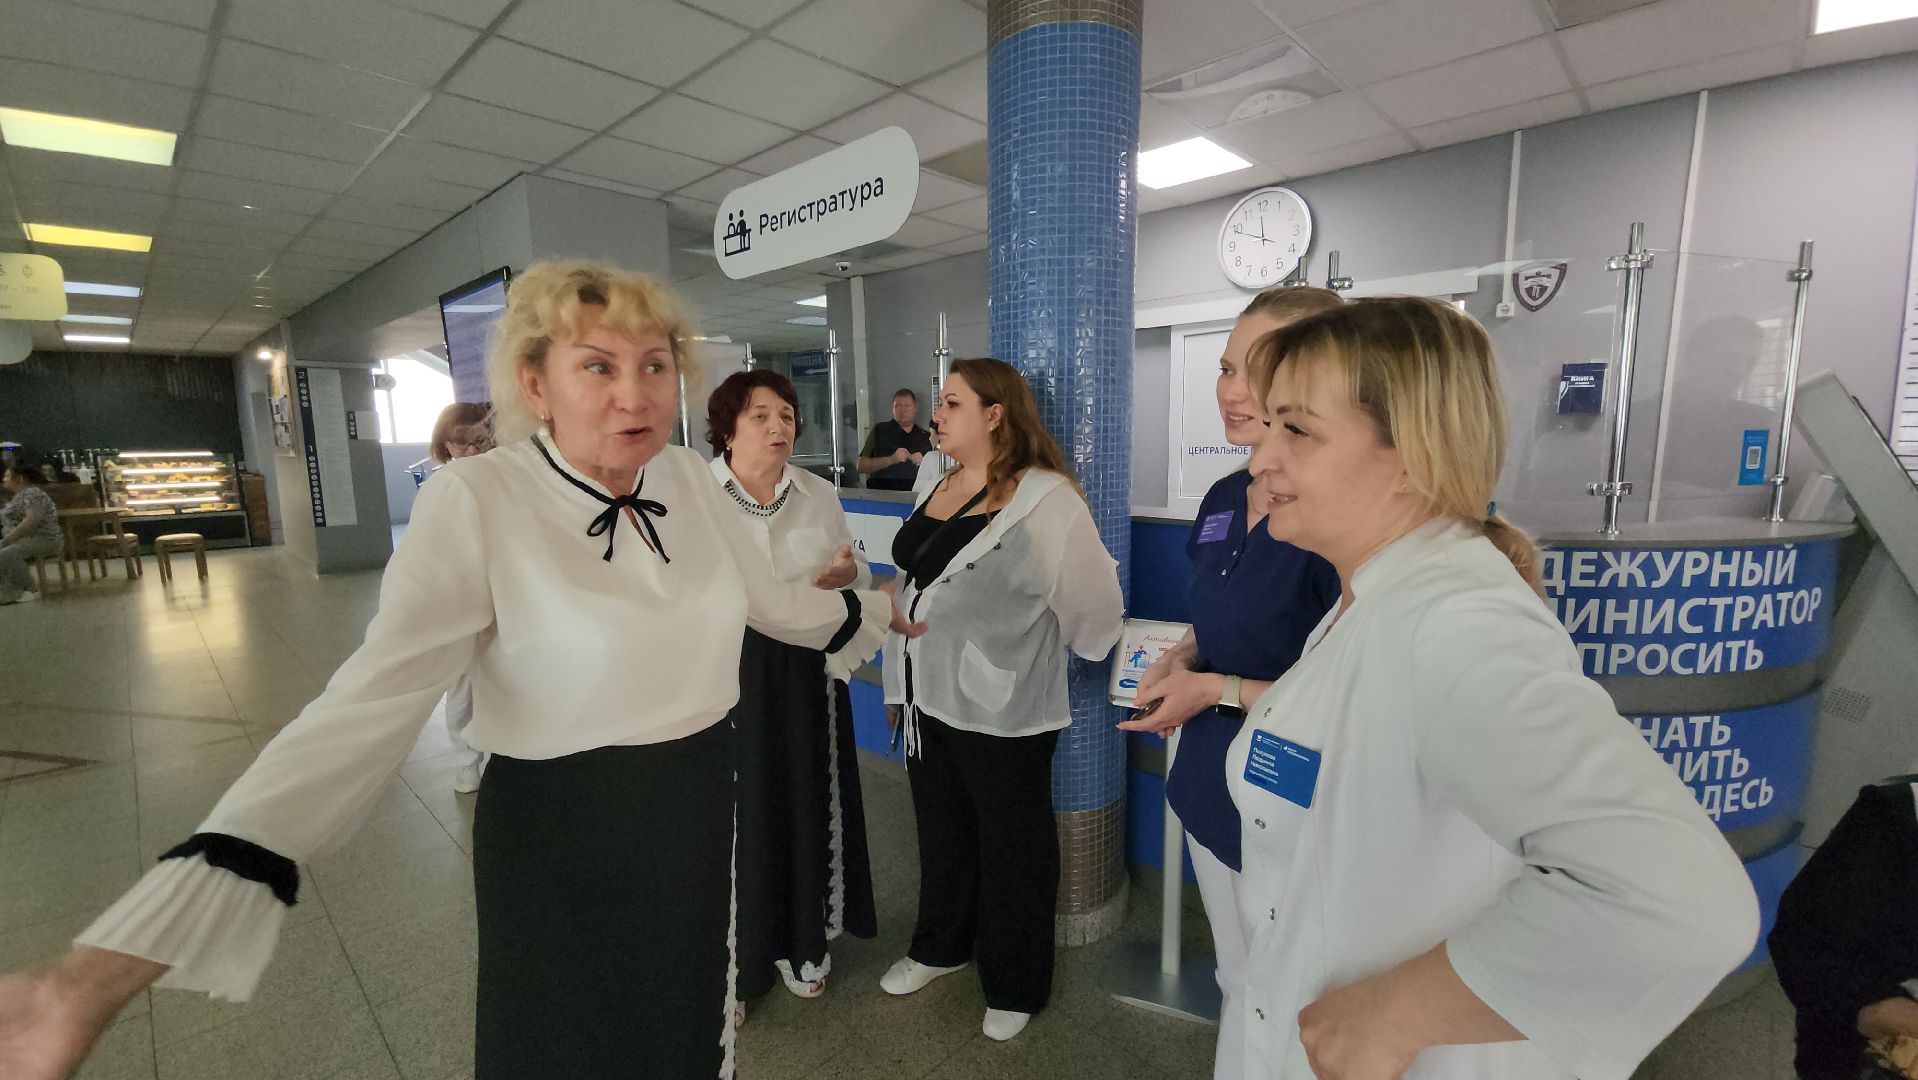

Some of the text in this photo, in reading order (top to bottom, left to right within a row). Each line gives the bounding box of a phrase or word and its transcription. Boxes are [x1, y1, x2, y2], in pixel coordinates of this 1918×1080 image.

[759, 176, 884, 236] Регистратура
[1258, 200, 1268, 212] 12
[1244, 208, 1253, 221] 11
[1288, 209, 1296, 221] 2
[1232, 222, 1243, 235] 10
[1292, 224, 1300, 237] 3
[1228, 241, 1236, 252] 9
[1288, 242, 1296, 254] 4
[1235, 255, 1242, 267] 8
[1276, 257, 1284, 270] 5
[1245, 264, 1253, 277] 7
[1260, 266, 1268, 278] 6
[1542, 543, 1798, 596] ДЕЖУРНЫЙ
[1688, 777, 1775, 822] ДЕСЬ
